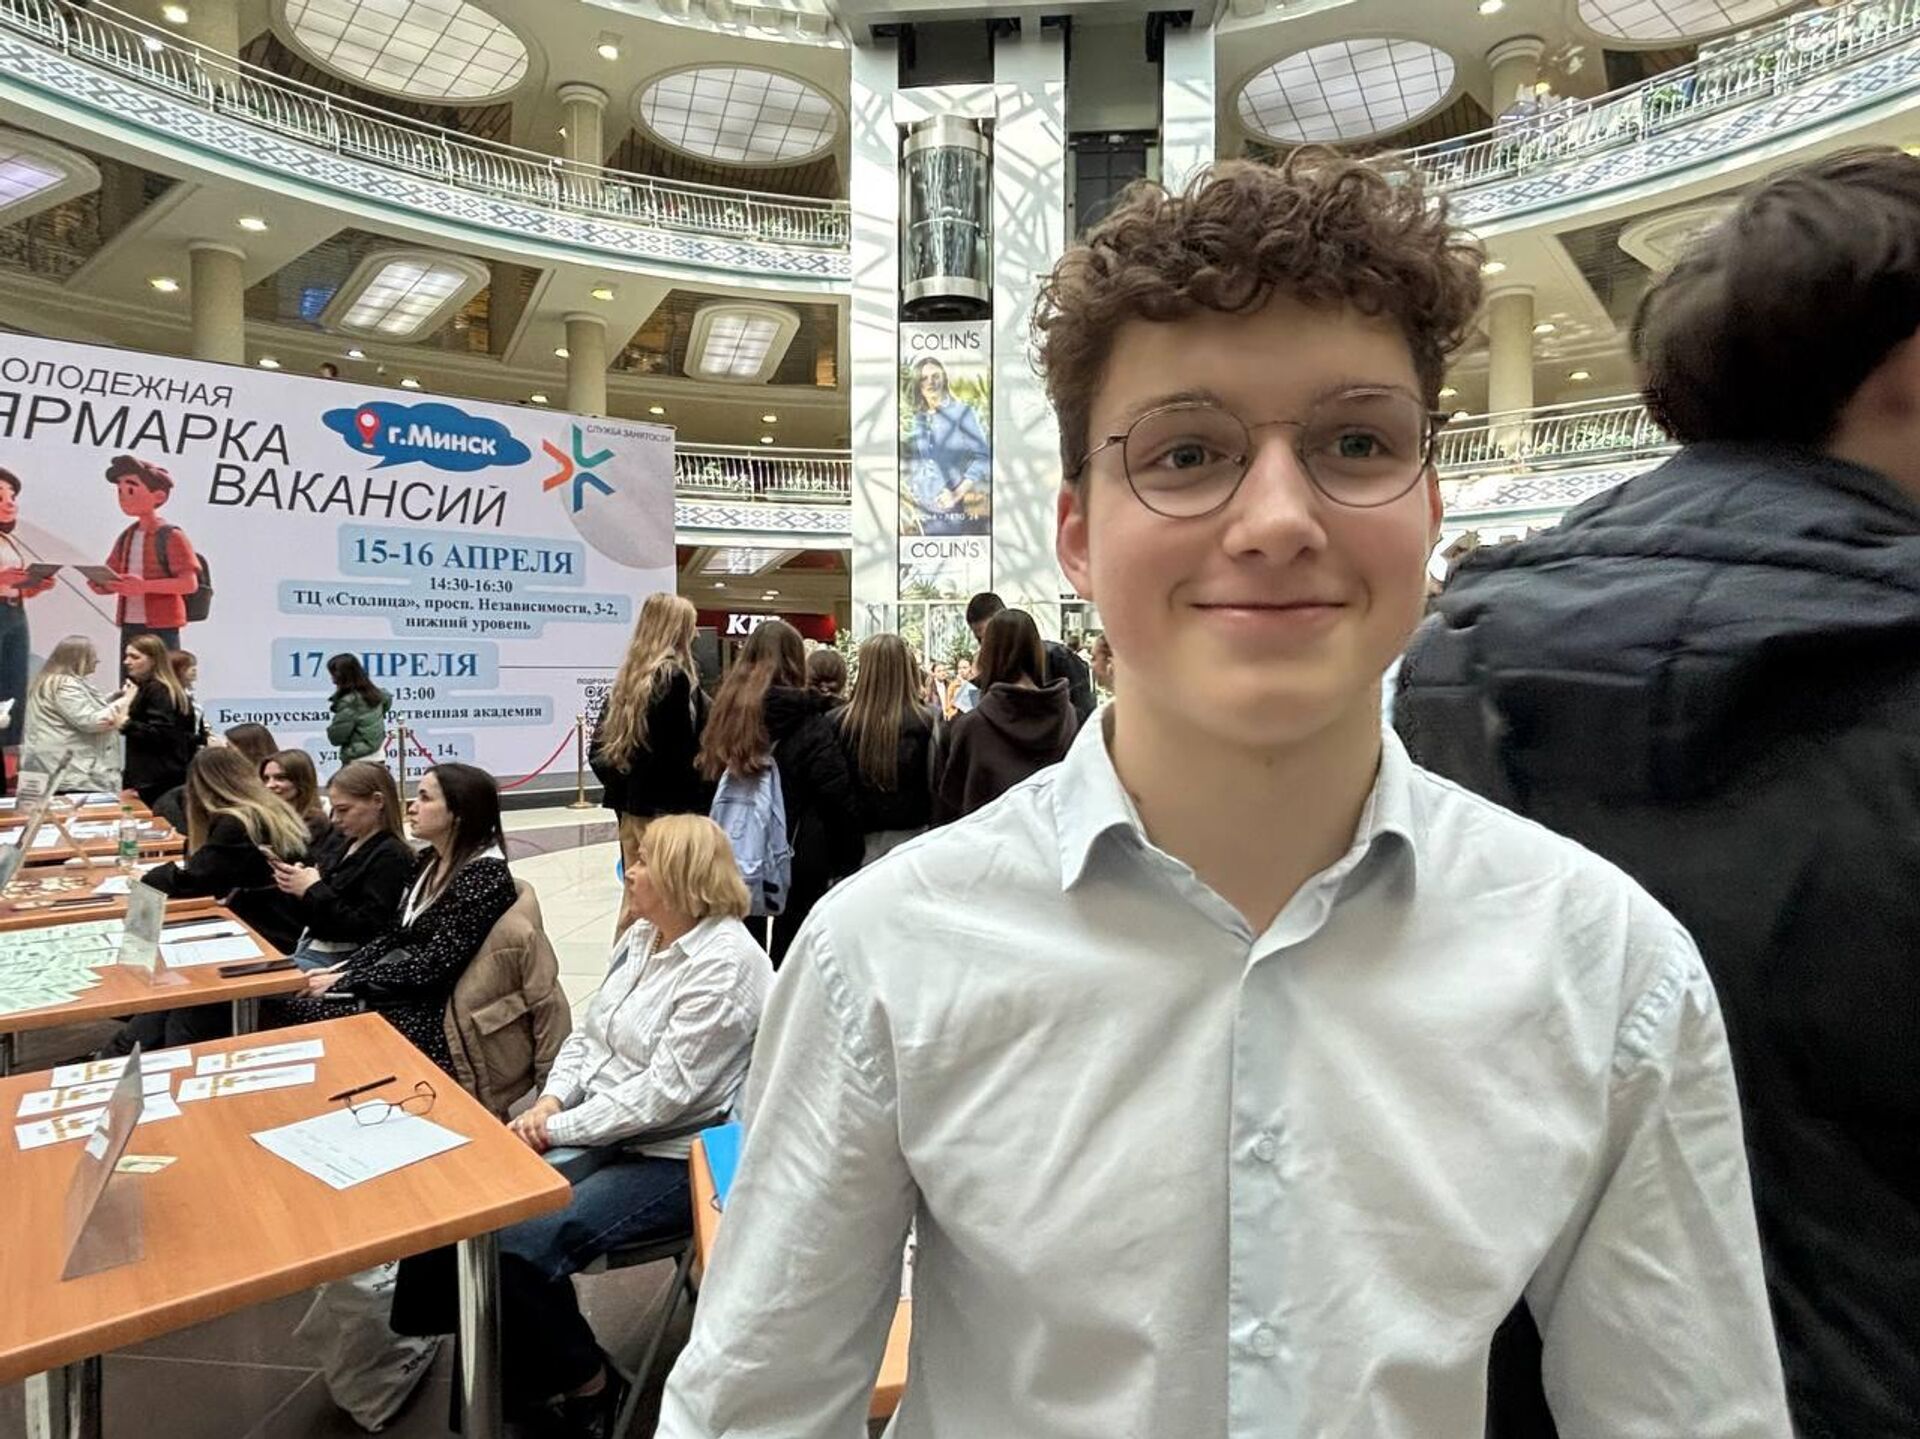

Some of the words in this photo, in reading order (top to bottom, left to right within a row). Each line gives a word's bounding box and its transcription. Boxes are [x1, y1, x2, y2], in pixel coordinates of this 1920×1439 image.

[911, 330, 980, 351] COLIN'S
[2, 358, 233, 408] ОЛОДЕЖНАЯ
[208, 462, 507, 526] ВАКАНСИЙ
[355, 538, 434, 567] 15-16
[443, 544, 574, 574] АПРЕЛЯ
[911, 540, 980, 559] COLIN'S
[430, 577, 513, 593] 14:30-16:30
[293, 590, 322, 607] ТЦ
[326, 591, 420, 609] «Столица»,
[424, 598, 474, 612] просп.
[479, 597, 591, 616] Независимости,
[406, 616, 468, 629] нижний
[472, 618, 532, 632] уровень
[726, 614, 781, 635] KF
[289, 652, 324, 677] 17
[361, 652, 478, 677] ПРЕЛЯ
[219, 708, 331, 725] Белорусская
[384, 708, 469, 723] рственная
[473, 707, 542, 718] академия
